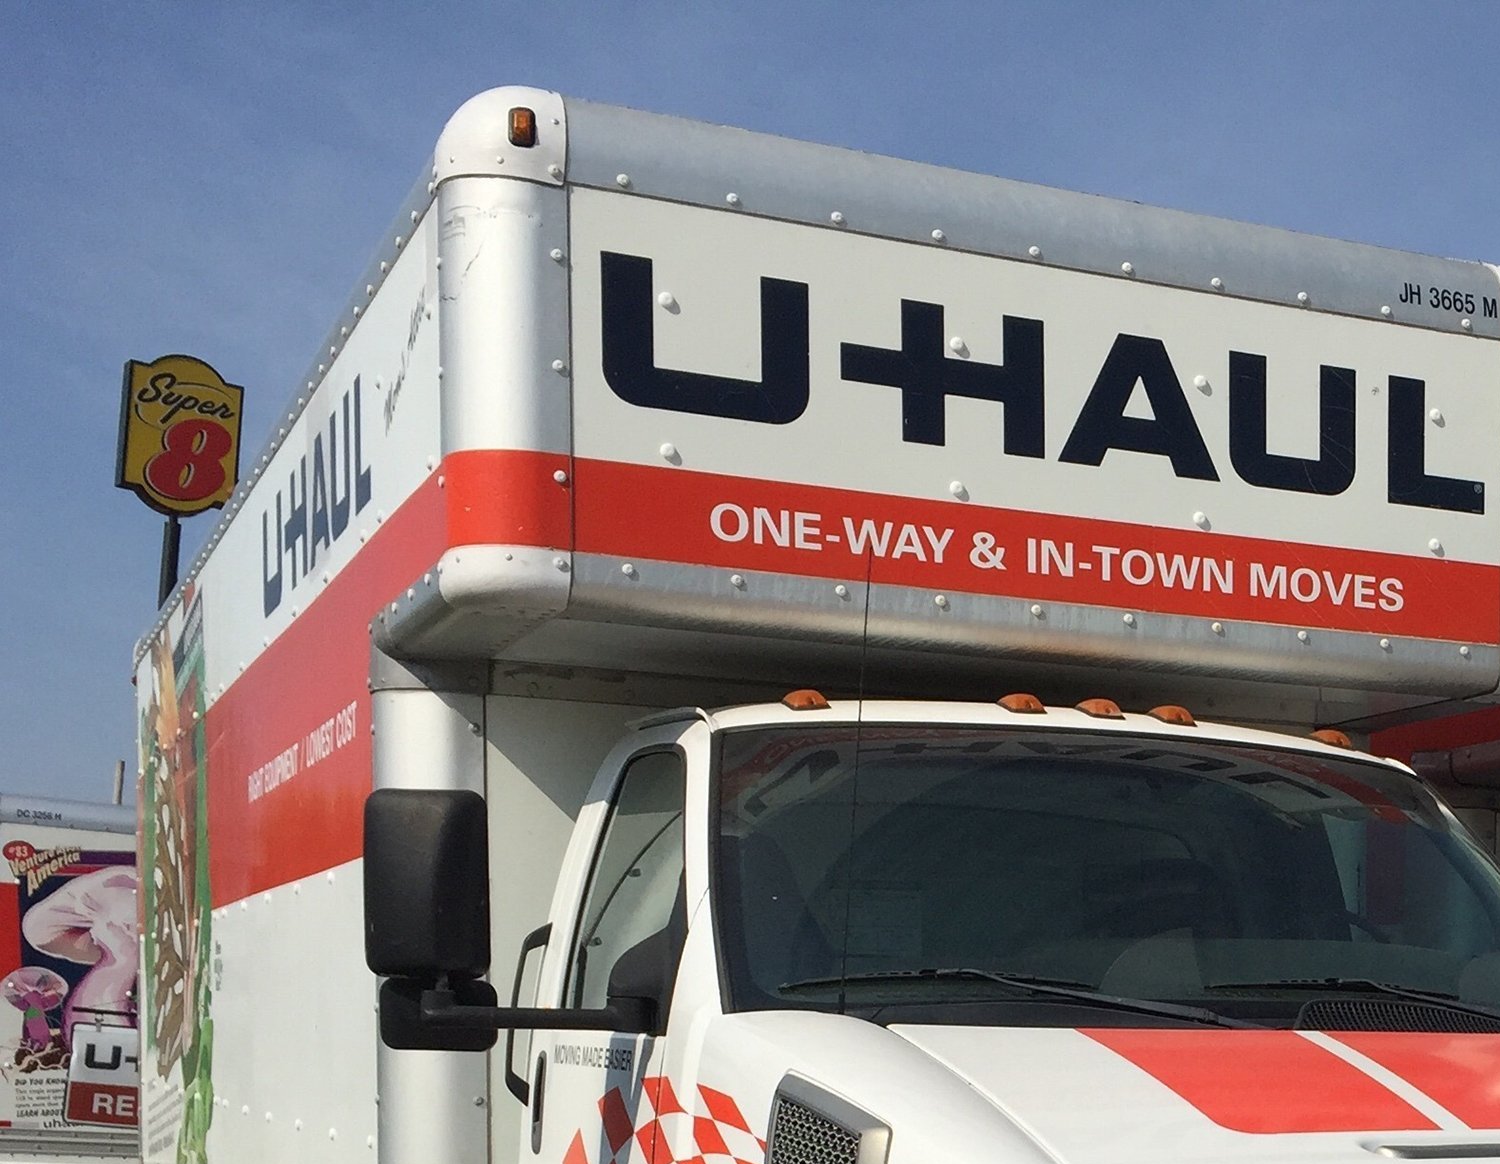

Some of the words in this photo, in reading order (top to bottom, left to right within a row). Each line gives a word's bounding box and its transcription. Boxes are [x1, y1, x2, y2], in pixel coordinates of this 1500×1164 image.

[1399, 282, 1421, 306] JH
[1429, 286, 1476, 315] 3665
[1482, 296, 1498, 319] M
[137, 372, 234, 425] Super
[600, 250, 1485, 516] U-HAUL
[143, 418, 233, 502] 8
[263, 373, 372, 619] U-HAUL
[709, 502, 954, 564] ONE-WAY
[969, 531, 1008, 572] &
[1026, 538, 1235, 595] IN-TOWN
[1249, 562, 1405, 613] MOVES
[336, 700, 358, 749] COST
[553, 1044, 581, 1066] MOVING
[581, 1045, 604, 1068] MADE
[604, 1047, 633, 1072] EASIER
